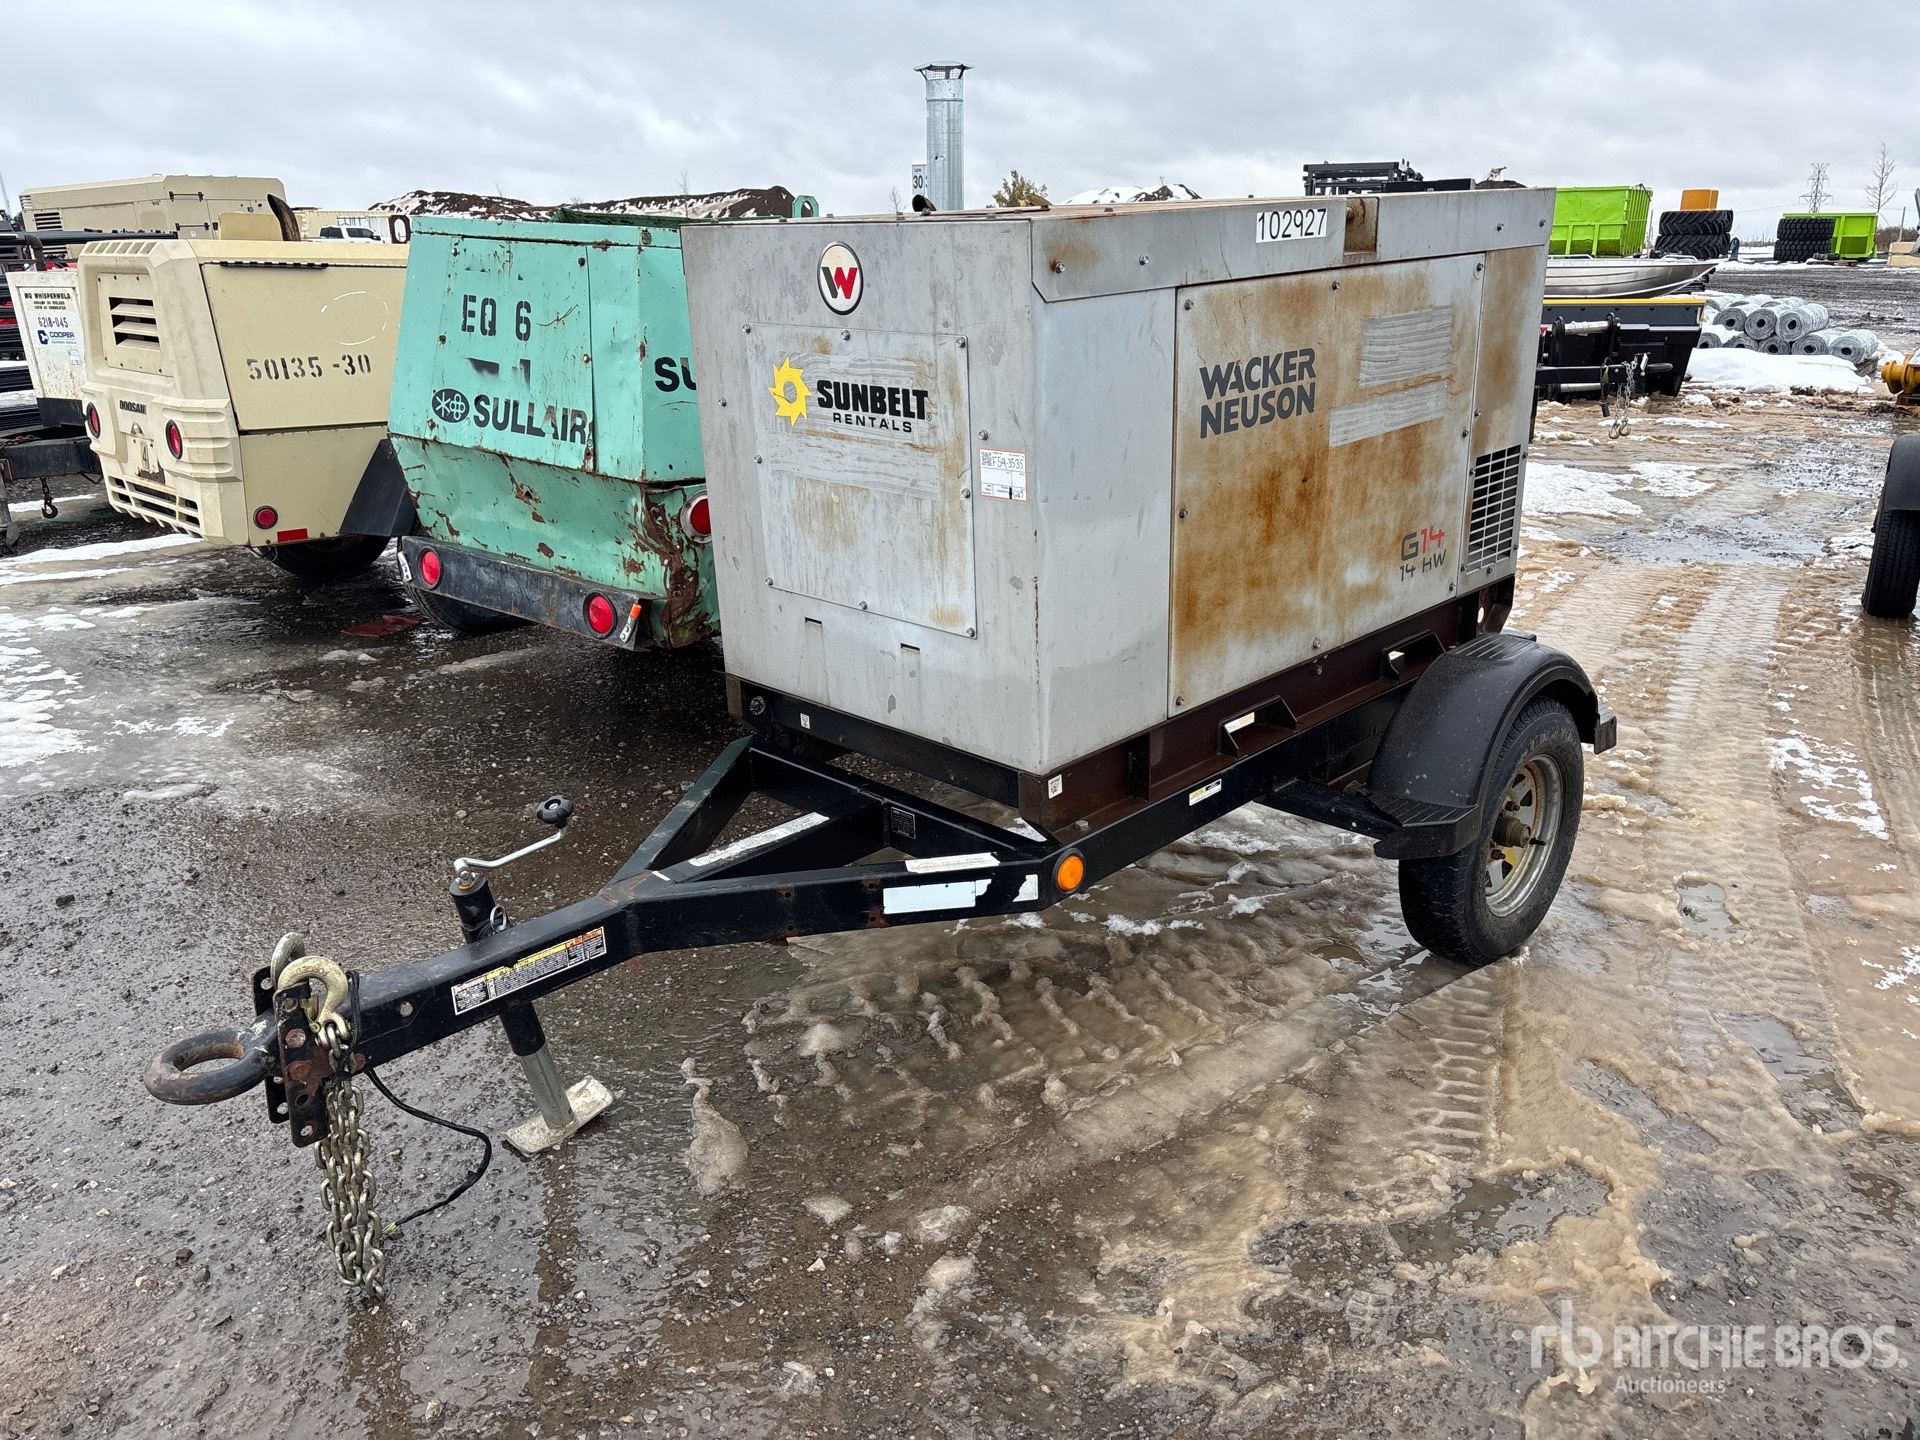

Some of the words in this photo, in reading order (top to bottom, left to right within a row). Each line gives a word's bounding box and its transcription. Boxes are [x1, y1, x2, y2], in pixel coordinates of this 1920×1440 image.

[912, 174, 924, 189] 30
[1258, 208, 1327, 240] 102927
[461, 294, 497, 337] EQ
[515, 300, 532, 342] 6
[1199, 347, 1317, 401] WACKER
[119, 400, 148, 415] DOOSAN
[816, 379, 929, 421] SUNBELT
[1199, 382, 1316, 439] NEUSON
[473, 394, 588, 445] SULLAIR
[832, 412, 913, 433] RENTALS
[1401, 525, 1446, 562] G14
[1400, 563, 1416, 582] 14
